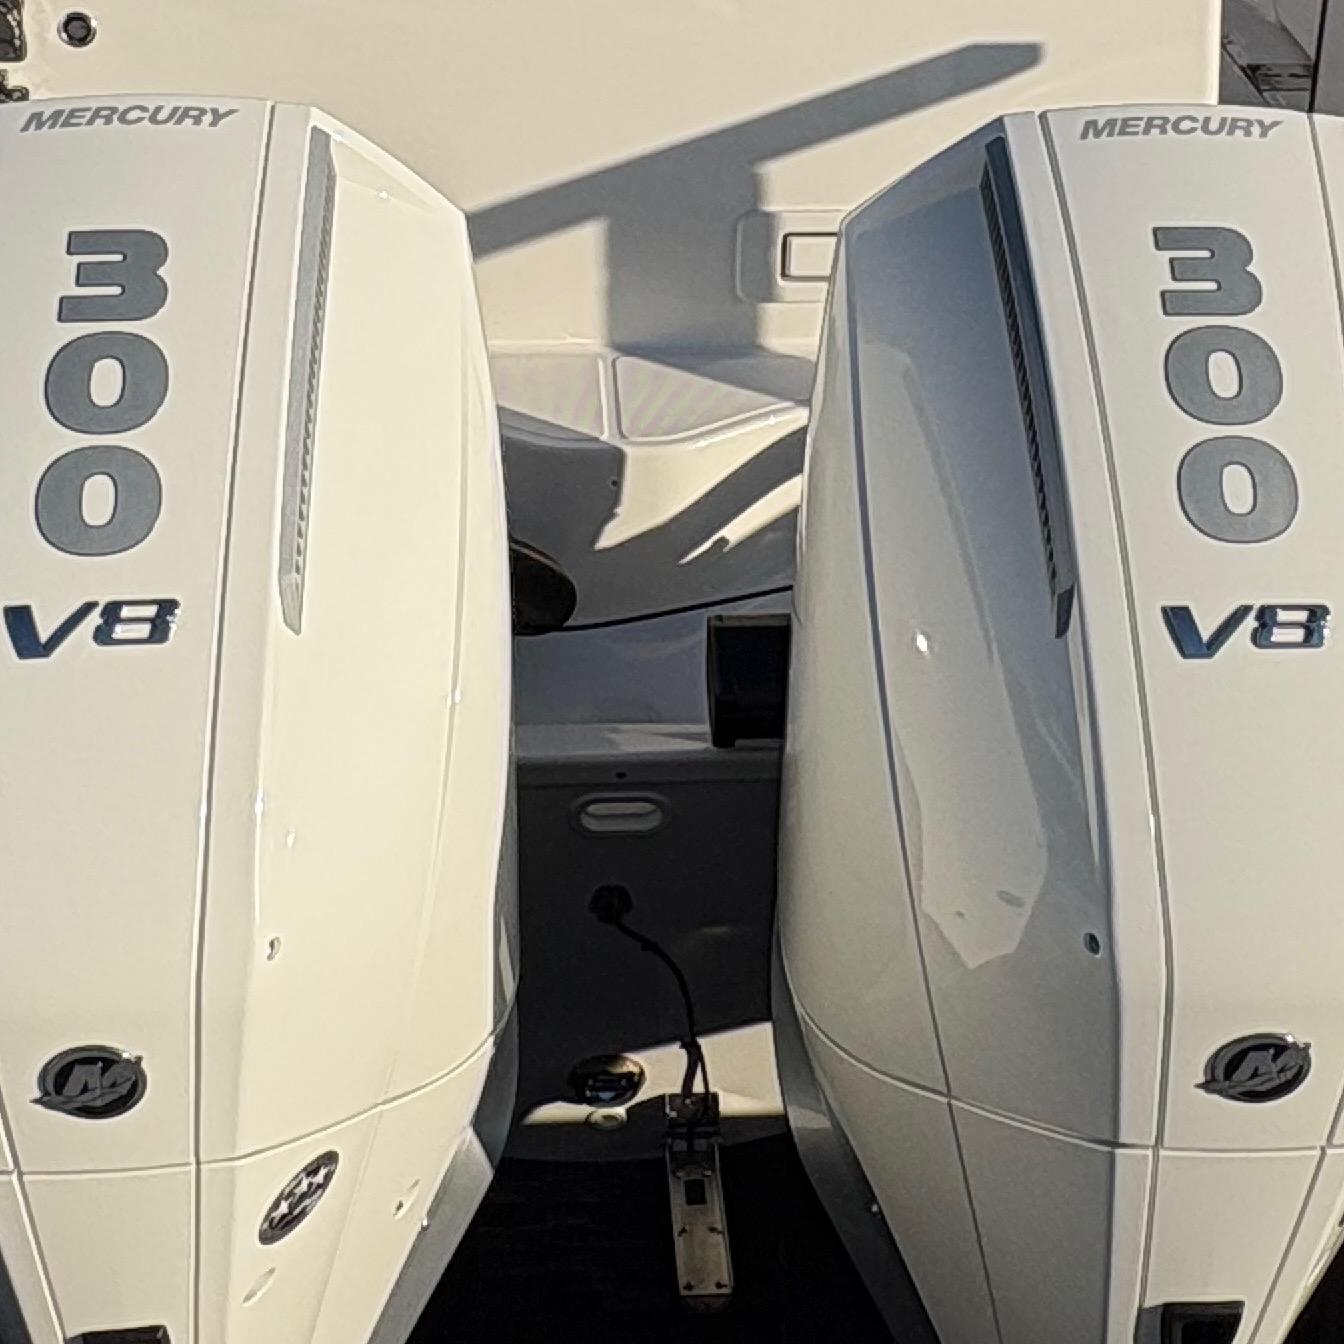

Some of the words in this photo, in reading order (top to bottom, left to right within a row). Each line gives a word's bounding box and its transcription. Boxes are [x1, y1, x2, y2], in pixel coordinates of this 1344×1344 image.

[19, 104, 241, 133] MERCURY
[1079, 113, 1285, 140] MERCURY
[34, 228, 170, 557] 300
[1151, 226, 1300, 545] 300
[2, 597, 181, 661] V8
[1160, 603, 1332, 660] V8
